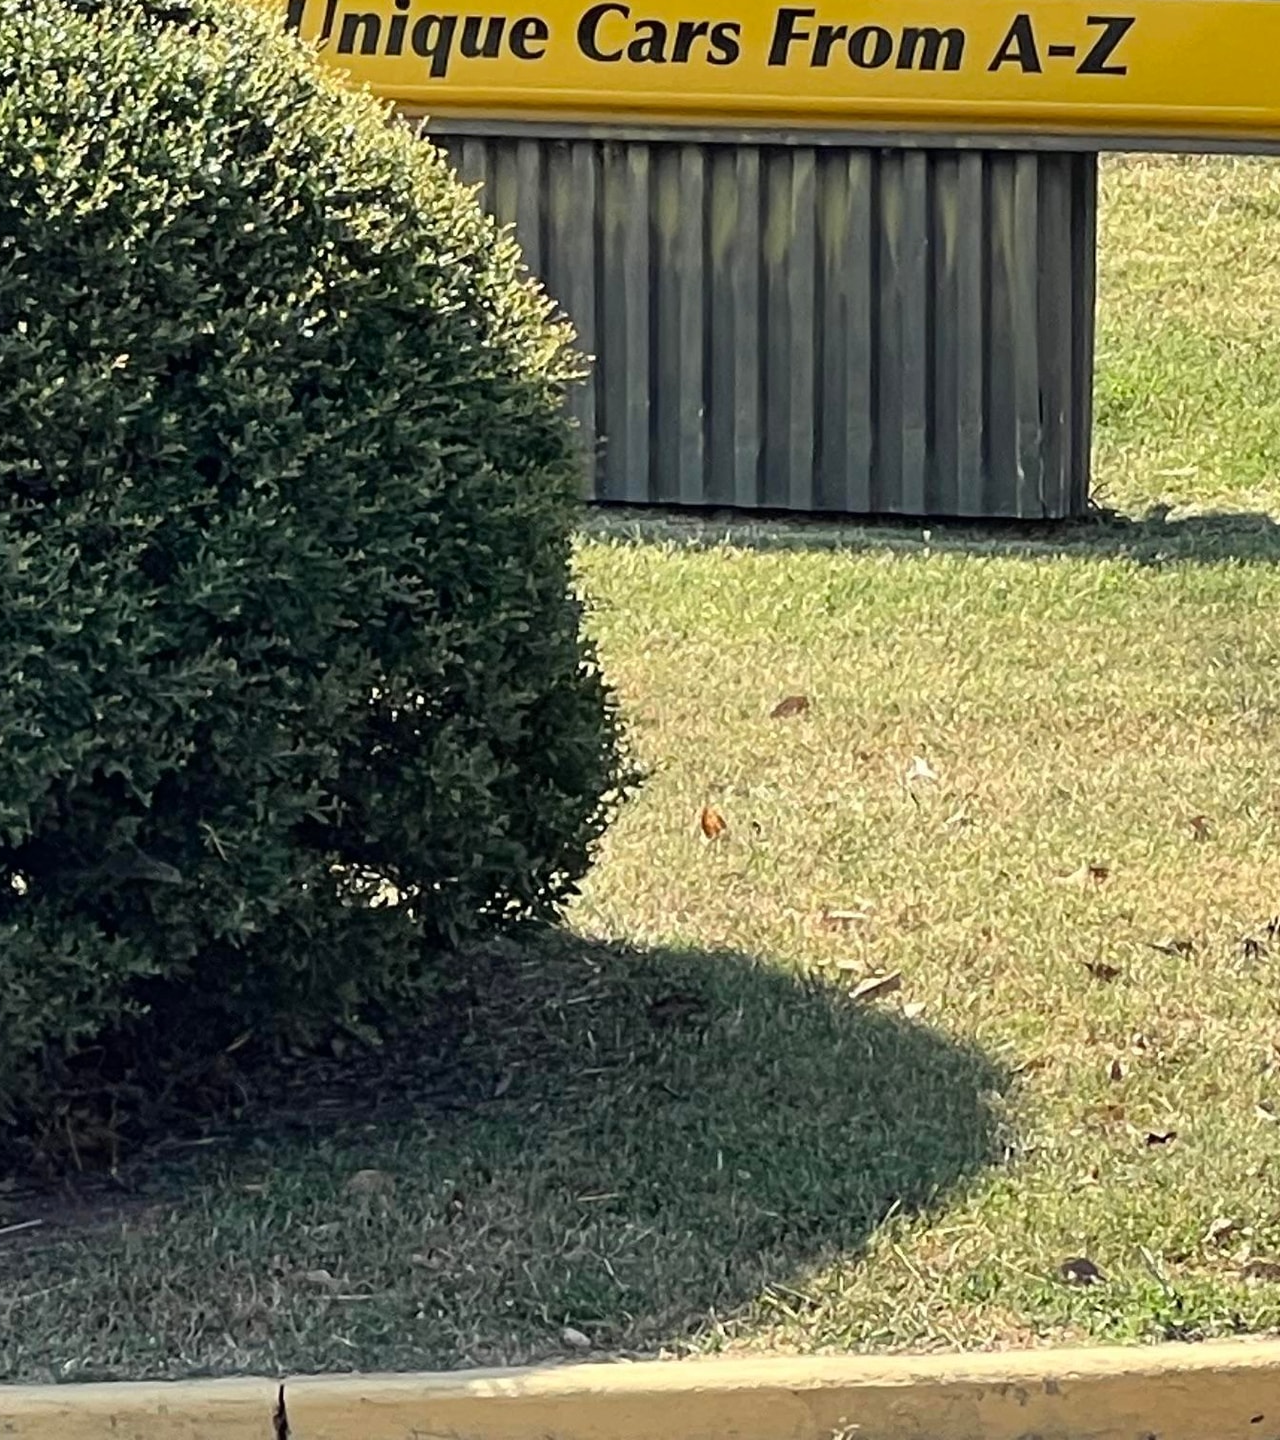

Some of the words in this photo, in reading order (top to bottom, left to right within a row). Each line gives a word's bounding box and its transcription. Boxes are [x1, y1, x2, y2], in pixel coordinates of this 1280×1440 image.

[575, 2, 742, 67] Cars
[766, 6, 966, 72] From
[986, 13, 1137, 77] A-Z
